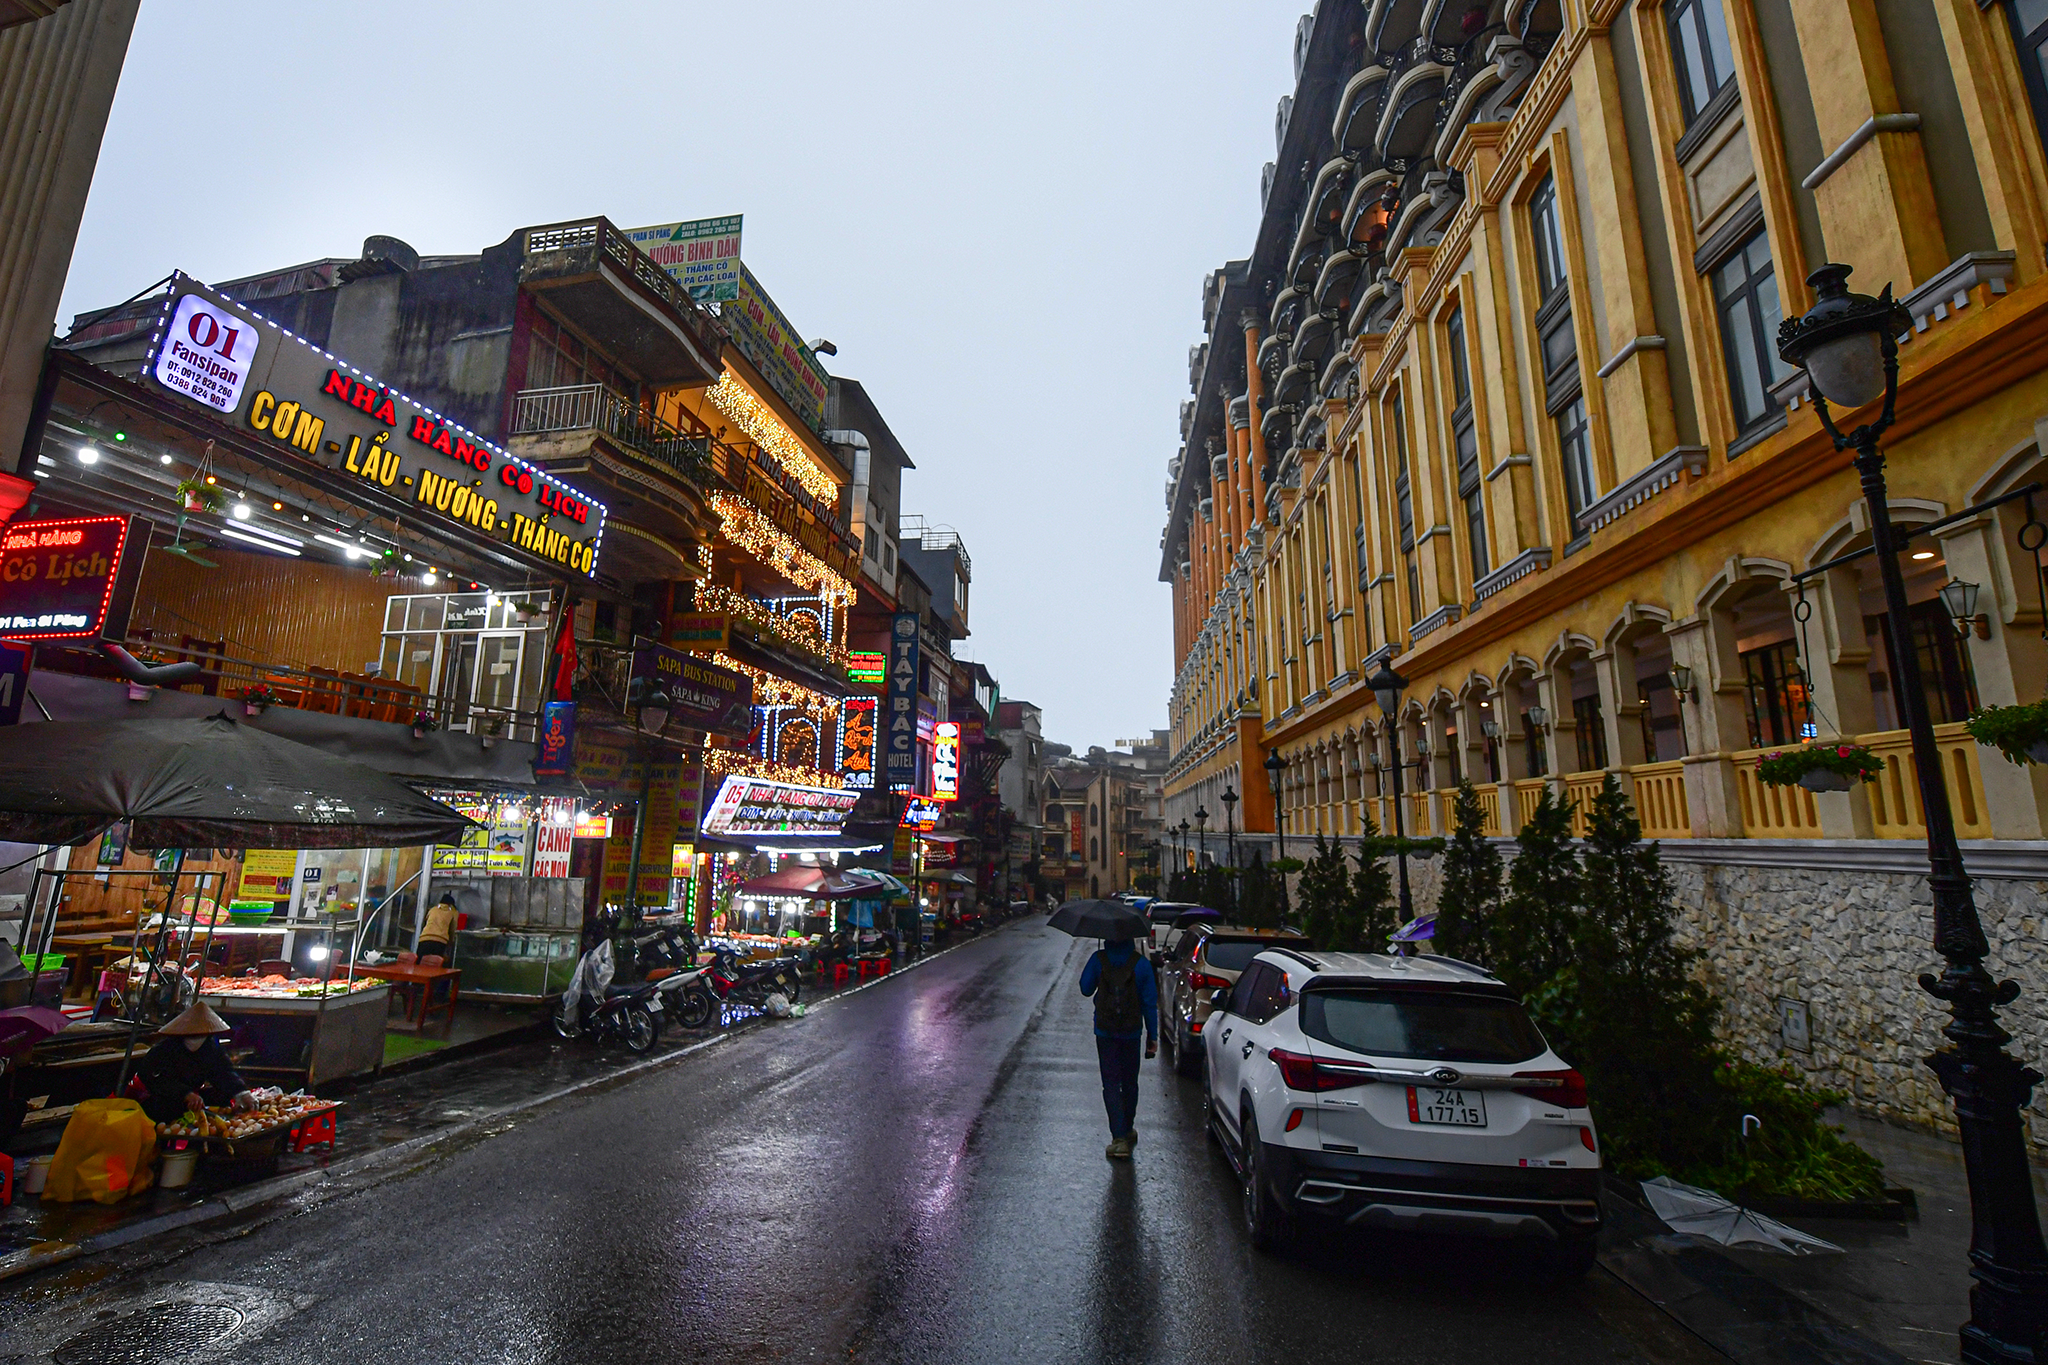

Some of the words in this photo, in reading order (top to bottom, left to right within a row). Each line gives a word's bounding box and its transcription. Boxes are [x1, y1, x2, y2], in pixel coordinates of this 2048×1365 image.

[687, 239, 714, 262] BÌNH
[716, 235, 739, 258] DÂN
[684, 276, 695, 285] PA
[697, 272, 715, 283] CÁC
[717, 271, 737, 282] LOẠI
[188, 312, 239, 363] 01
[171, 340, 239, 386] Fansipan
[166, 373, 190, 390] 0388
[191, 385, 208, 399] 624
[209, 393, 227, 407] 905
[167, 360, 180, 373] ĐT:
[180, 367, 202, 383] 0912
[201, 376, 217, 391] 828
[217, 384, 233, 398] 260
[323, 369, 397, 427] NHÀ
[411, 415, 492, 472] HÀNG
[501, 464, 534, 495] CÔ
[540, 483, 590, 524] LỊCH
[250, 390, 326, 455] CƠM
[345, 431, 402, 487] LẨU
[417, 469, 499, 532] NƯỚNG
[510, 512, 571, 564] THẮNG
[7, 531, 37, 549] NHÀ
[39, 529, 83, 546] HÀNG
[3, 555, 38, 582] Cô
[45, 552, 108, 586] Lịch
[657, 654, 681, 676] SAPA
[683, 663, 701, 682] BUS
[702, 670, 737, 692] STATION
[671, 685, 692, 702] SAPA
[700, 694, 721, 709] KING
[542, 716, 567, 764] Tiger
[888, 753, 913, 768] HOTEL
[725, 785, 745, 804] 05
[839, 797, 857, 809] ANH
[537, 827, 572, 854] CANH
[305, 868, 318, 877] 01
[534, 856, 549, 877] CÁC
[550, 855, 568, 878] MÓN
[1435, 1089, 1465, 1107] 24A
[1427, 1106, 1479, 1124] 177.15
